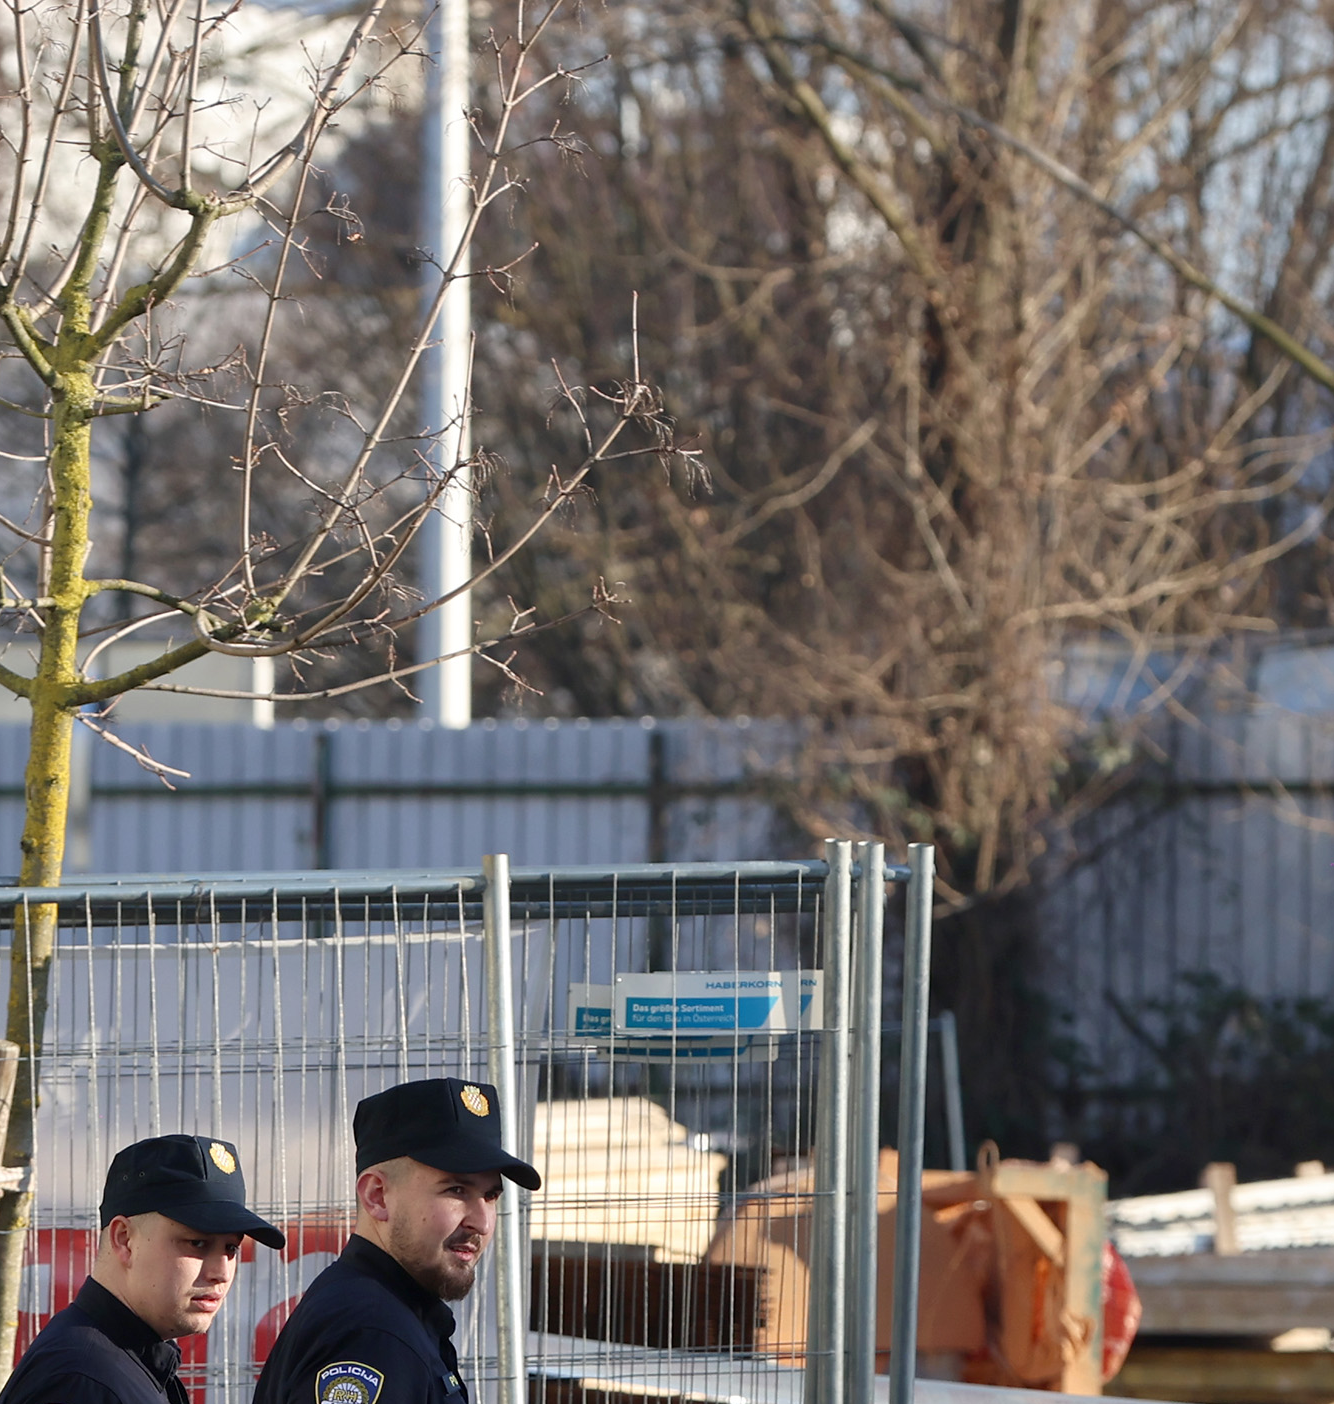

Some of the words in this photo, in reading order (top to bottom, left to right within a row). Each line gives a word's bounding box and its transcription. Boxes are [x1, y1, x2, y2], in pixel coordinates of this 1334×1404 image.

[705, 980, 783, 990] HABERKORN
[632, 1003, 649, 1012] Das
[680, 1004, 724, 1013] Sortiment
[320, 1366, 379, 1387] POLICIJA
[333, 1388, 358, 1403] RH
